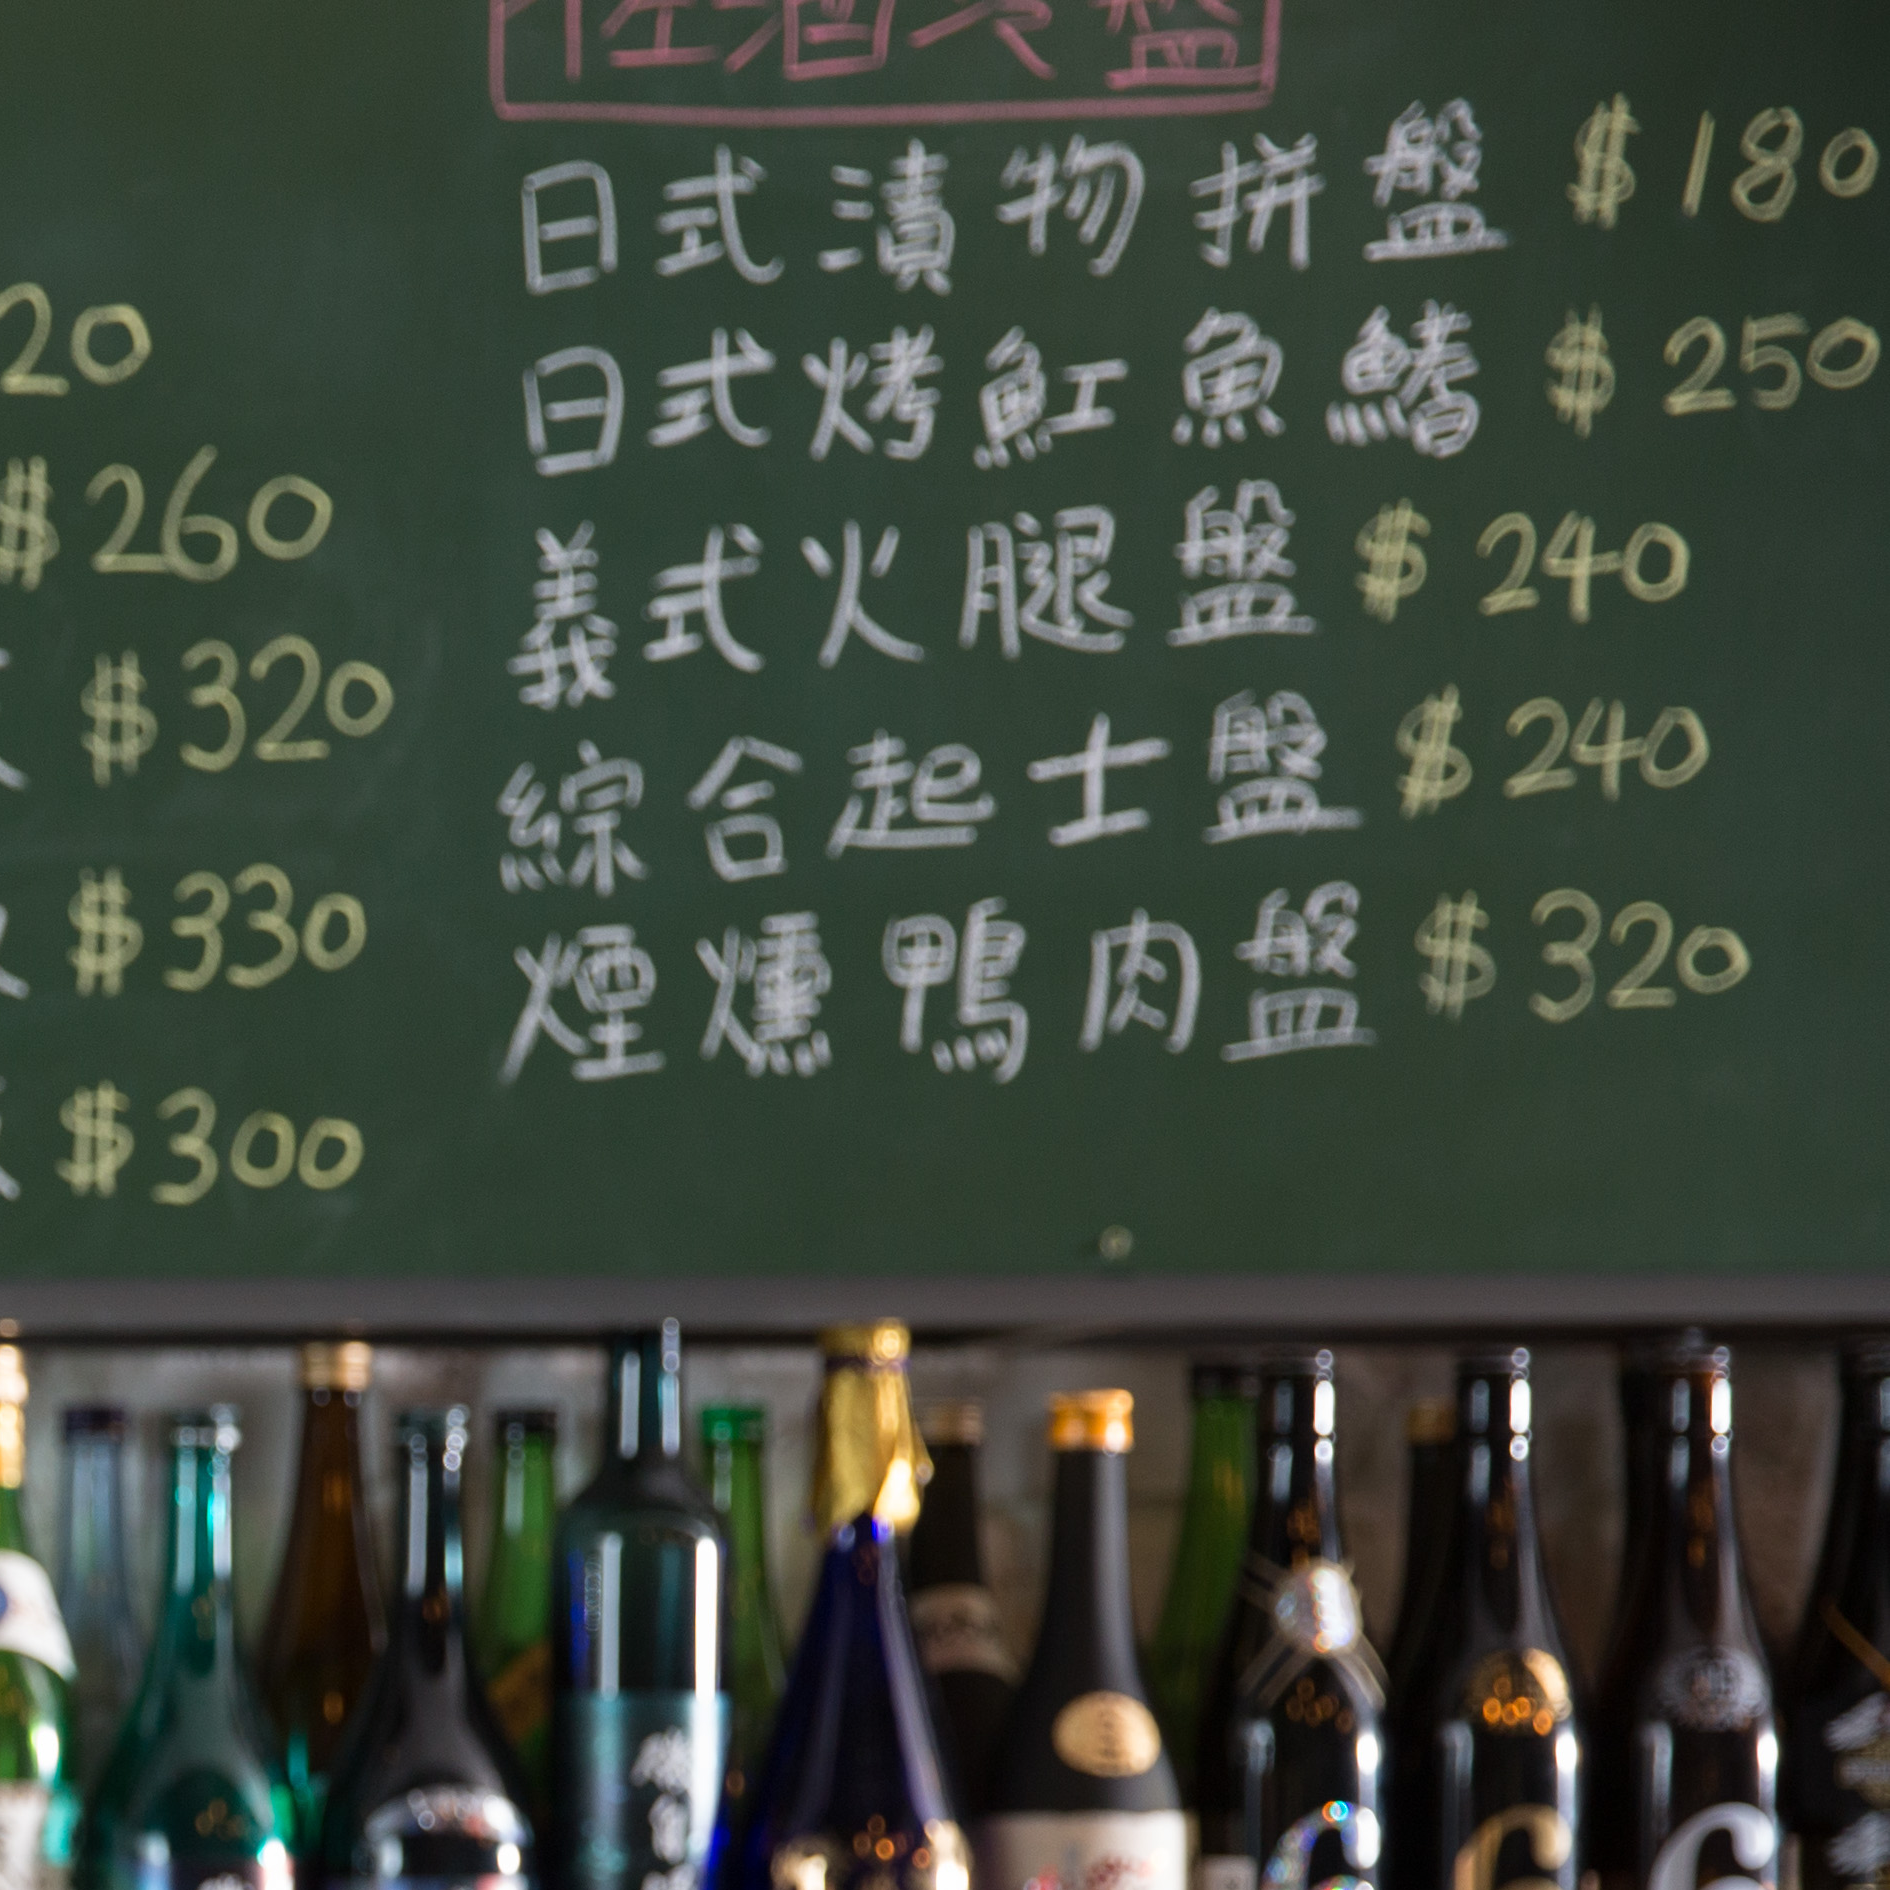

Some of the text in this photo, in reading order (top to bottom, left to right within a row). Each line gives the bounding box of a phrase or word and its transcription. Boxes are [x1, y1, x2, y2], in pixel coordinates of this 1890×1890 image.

[522, 91, 1880, 297] 日式漬物拼盤 $180
[1544, 301, 1882, 440] $250
[507, 478, 1691, 709] 義式火腿盤 $240
[80, 634, 394, 786] $320
[496, 683, 1711, 898] 綜合起士盤 $240
[66, 862, 368, 996] $330
[501, 879, 1752, 1087] 煙燻鴨肉盤 $320
[56, 1081, 364, 1204] $300
